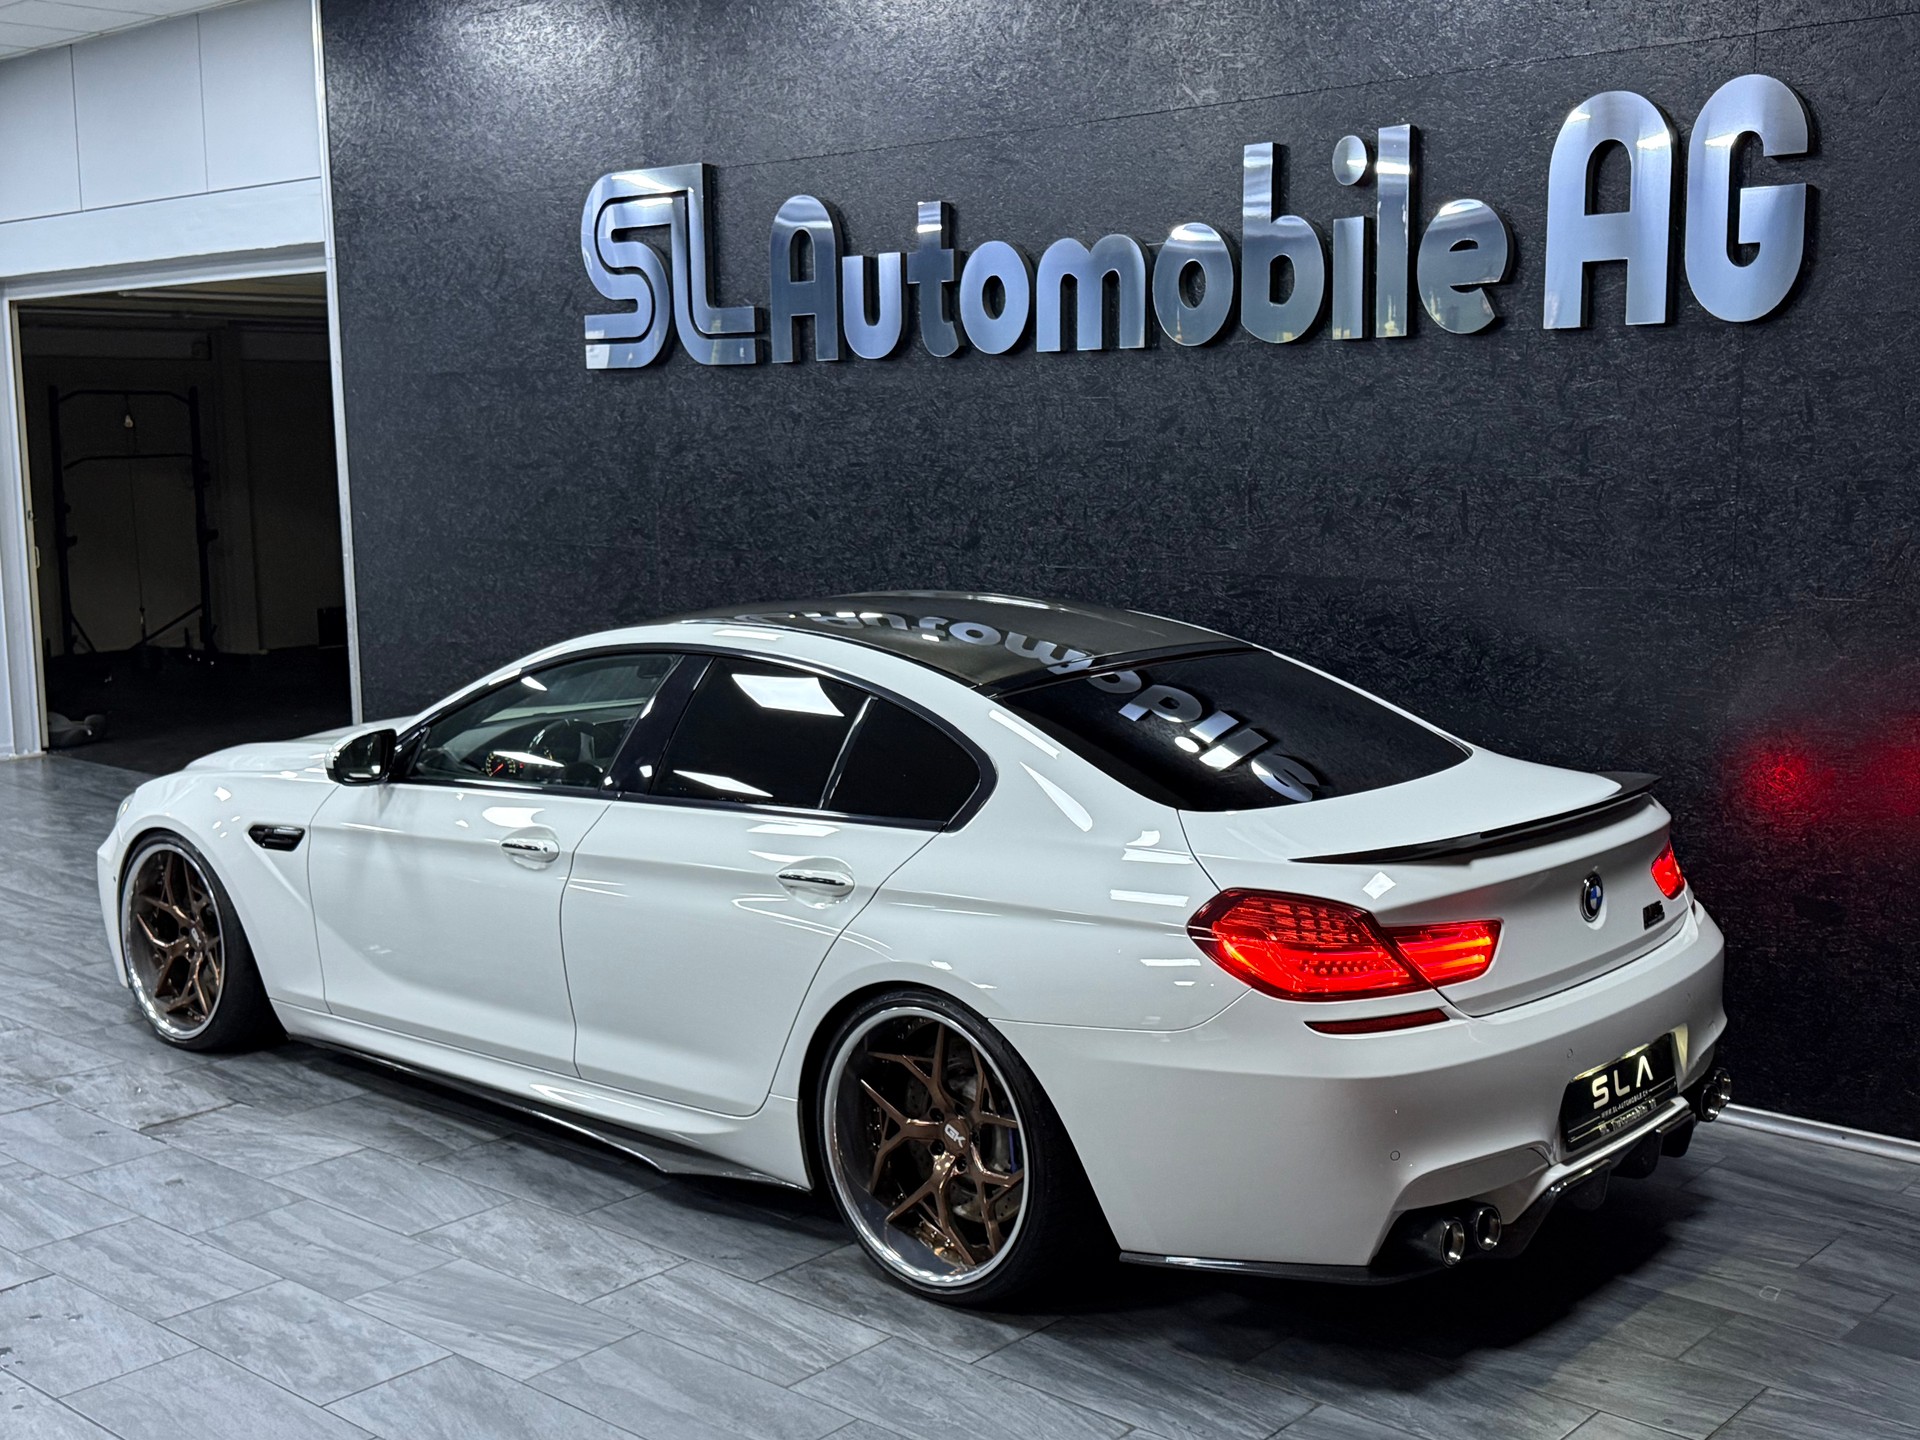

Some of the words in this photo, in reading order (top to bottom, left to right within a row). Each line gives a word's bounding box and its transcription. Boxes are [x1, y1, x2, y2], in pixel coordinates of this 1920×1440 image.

[581, 163, 755, 369] SL
[770, 124, 1508, 363] Automobile
[1543, 74, 1808, 329] AG
